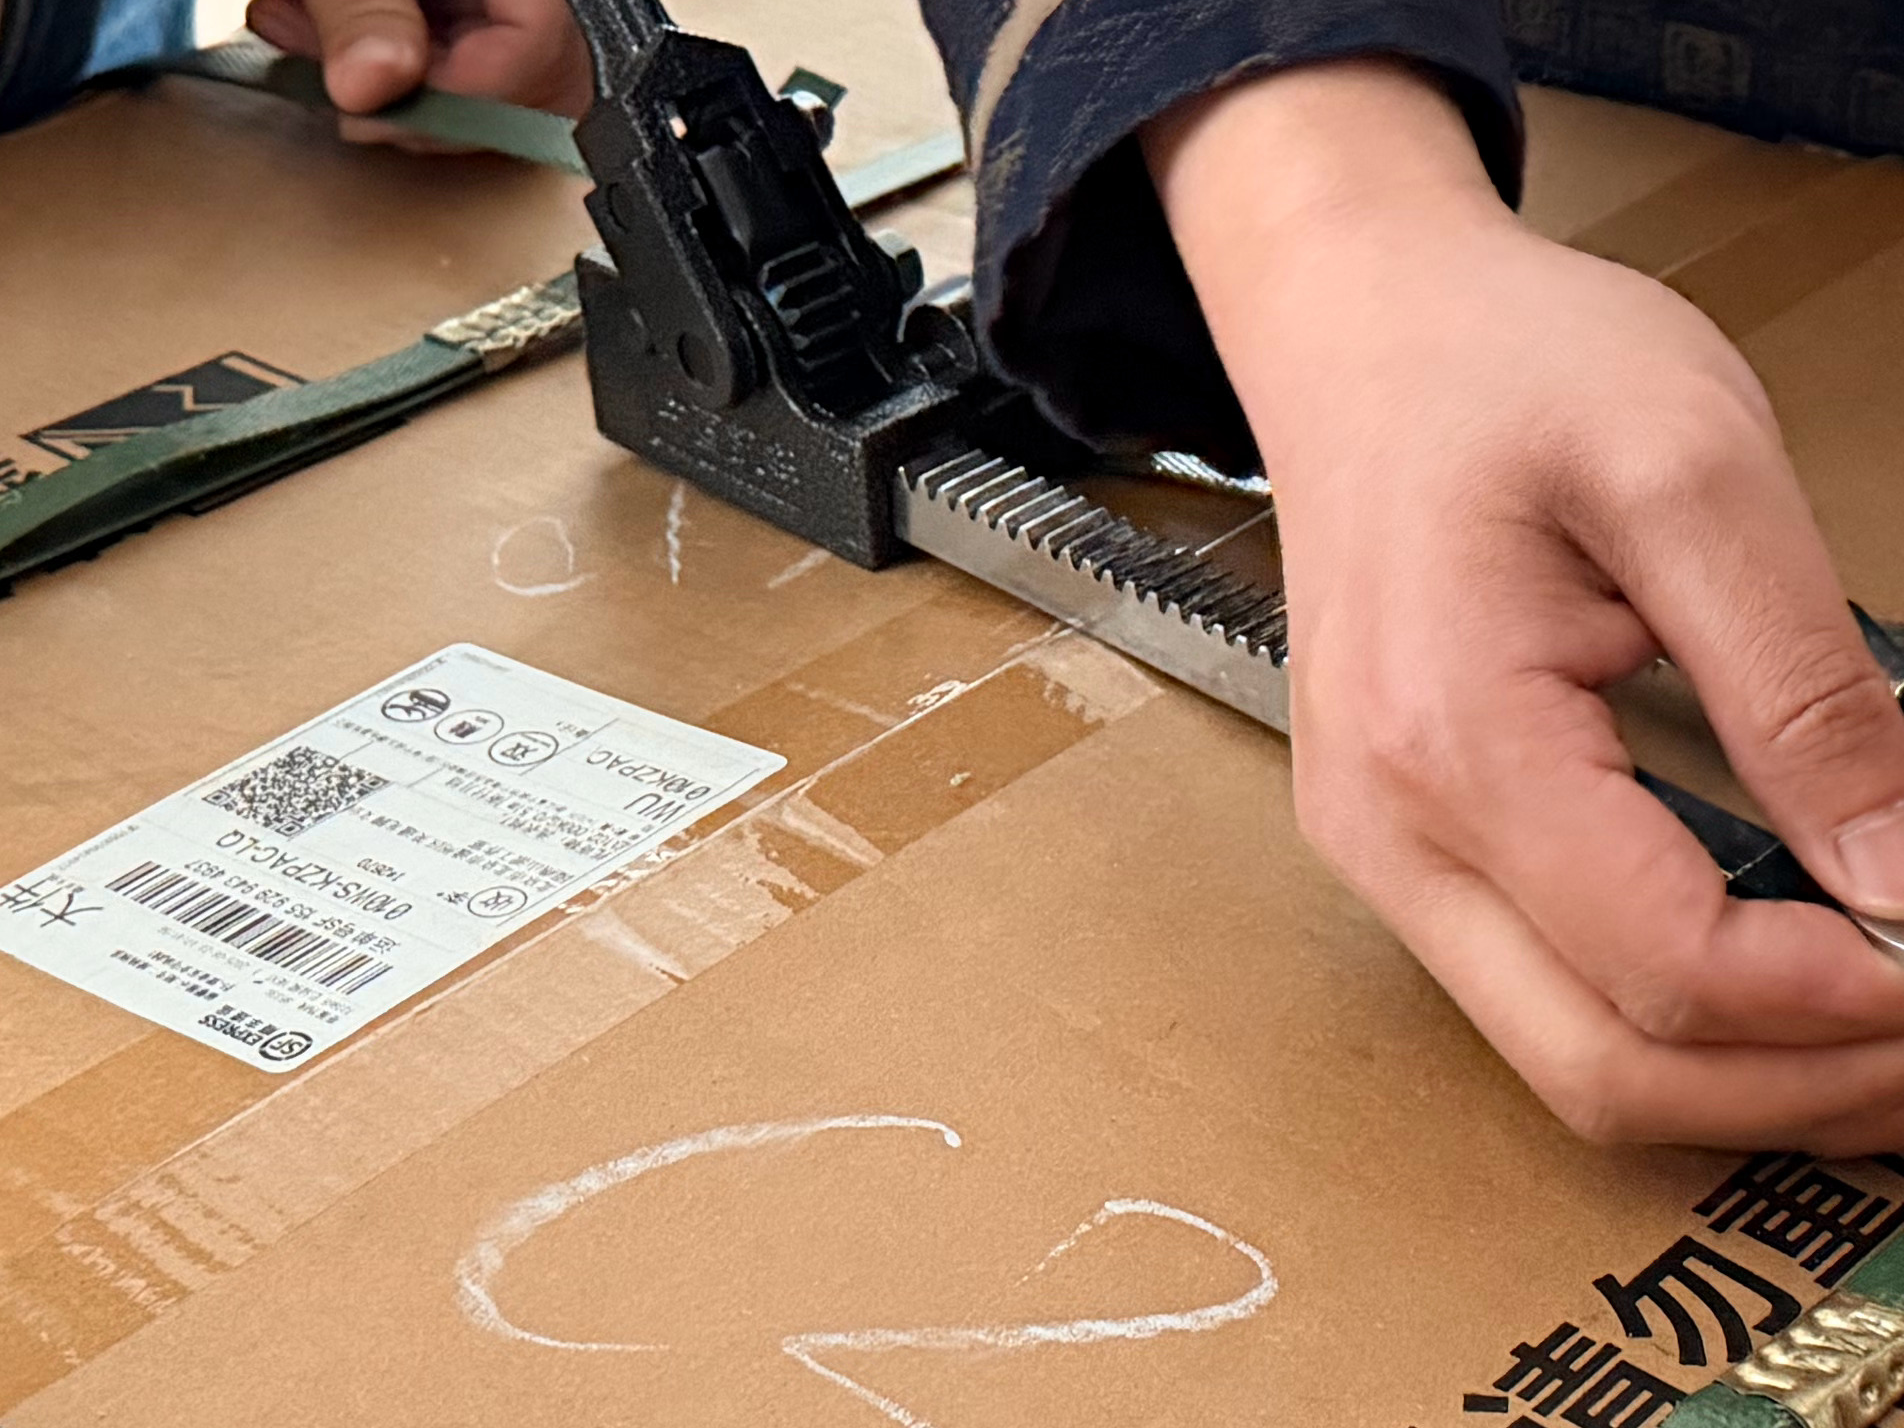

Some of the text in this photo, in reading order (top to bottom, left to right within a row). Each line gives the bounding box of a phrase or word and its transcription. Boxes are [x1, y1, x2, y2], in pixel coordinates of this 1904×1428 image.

[620, 790, 690, 823] WU
[180, 857, 231, 881] 4937
[218, 874, 263, 895] 943
[250, 887, 292, 908] 929
[281, 901, 320, 921] 155
[195, 1012, 265, 1046] EXPRESS
